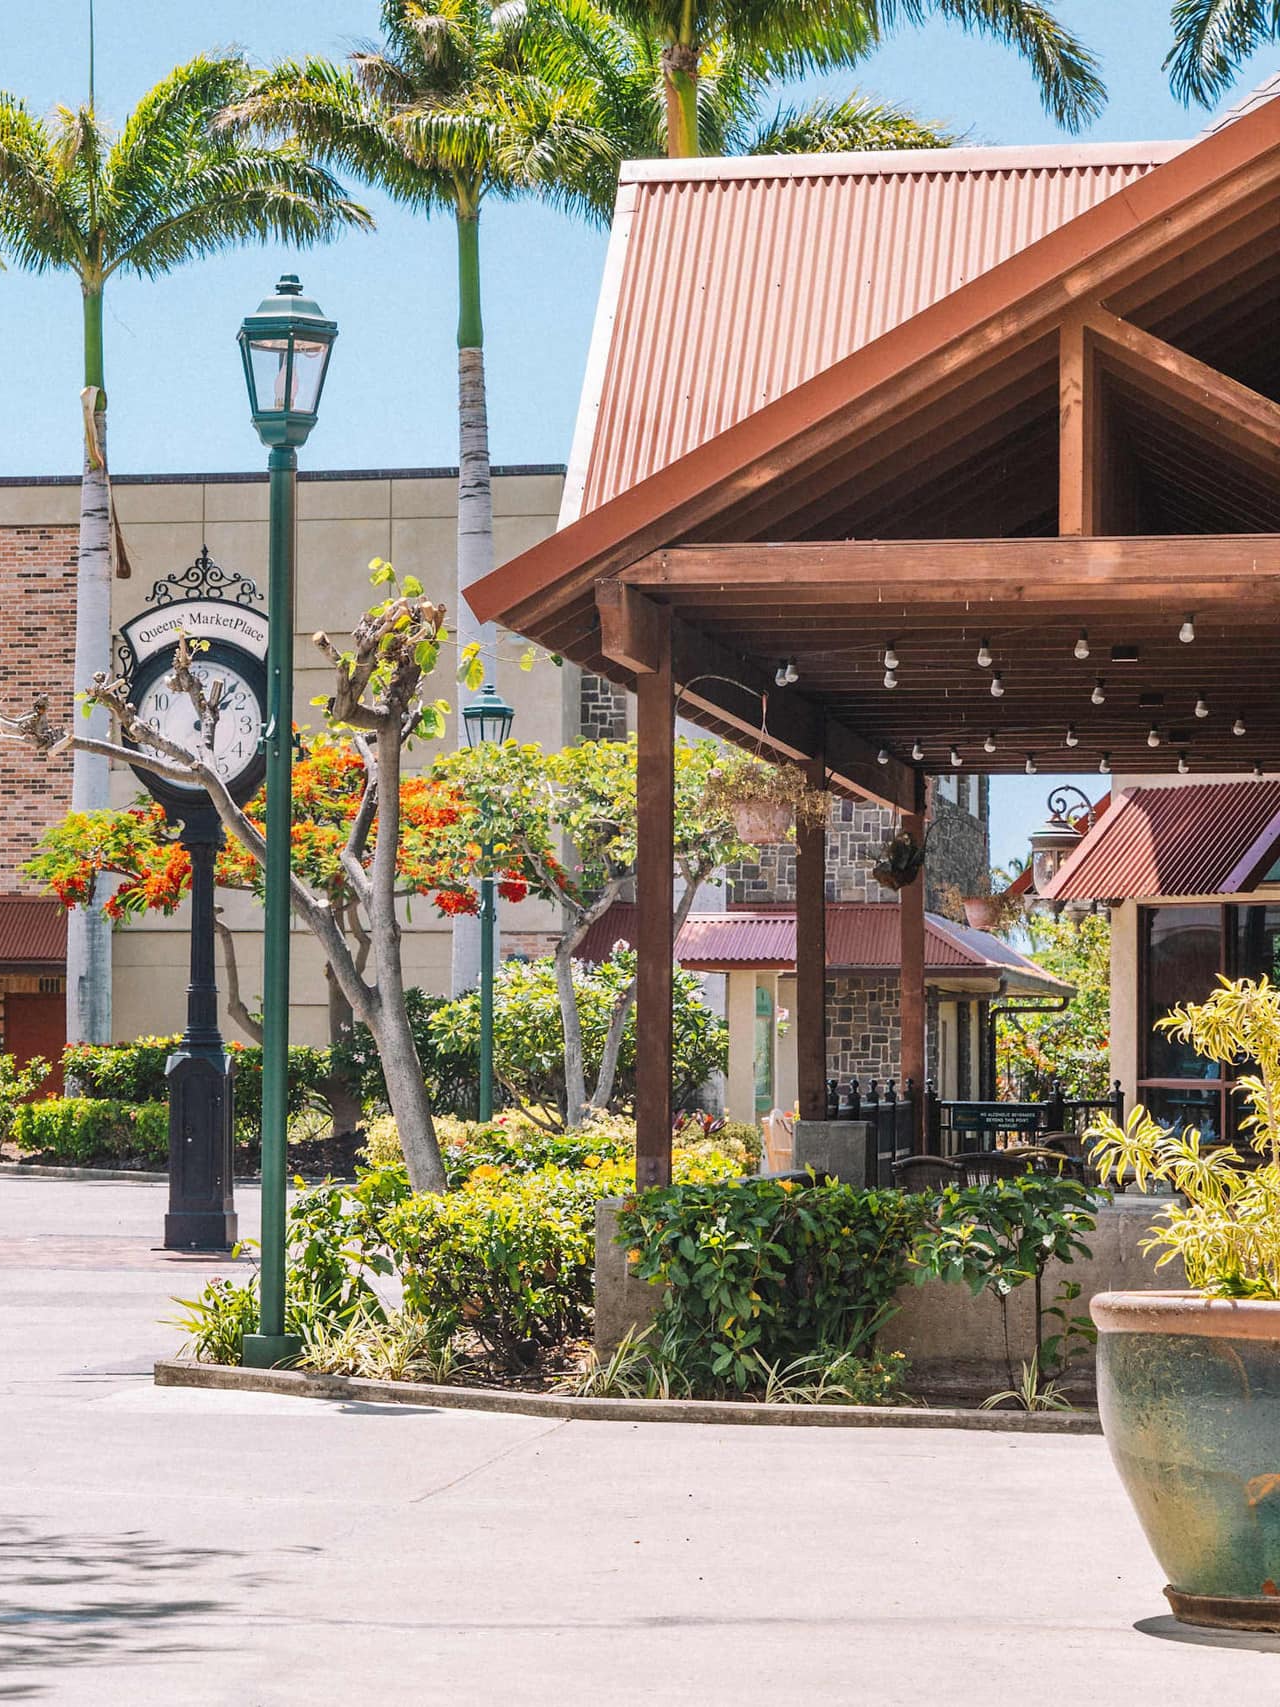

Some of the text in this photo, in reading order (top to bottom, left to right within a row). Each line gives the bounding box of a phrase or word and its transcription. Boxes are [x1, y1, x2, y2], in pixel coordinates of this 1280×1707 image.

[139, 612, 264, 643] Queens' MarketPlace
[154, 694, 169, 711] 10
[234, 692, 247, 711] 2
[240, 716, 252, 734] 3
[231, 741, 246, 758] 4
